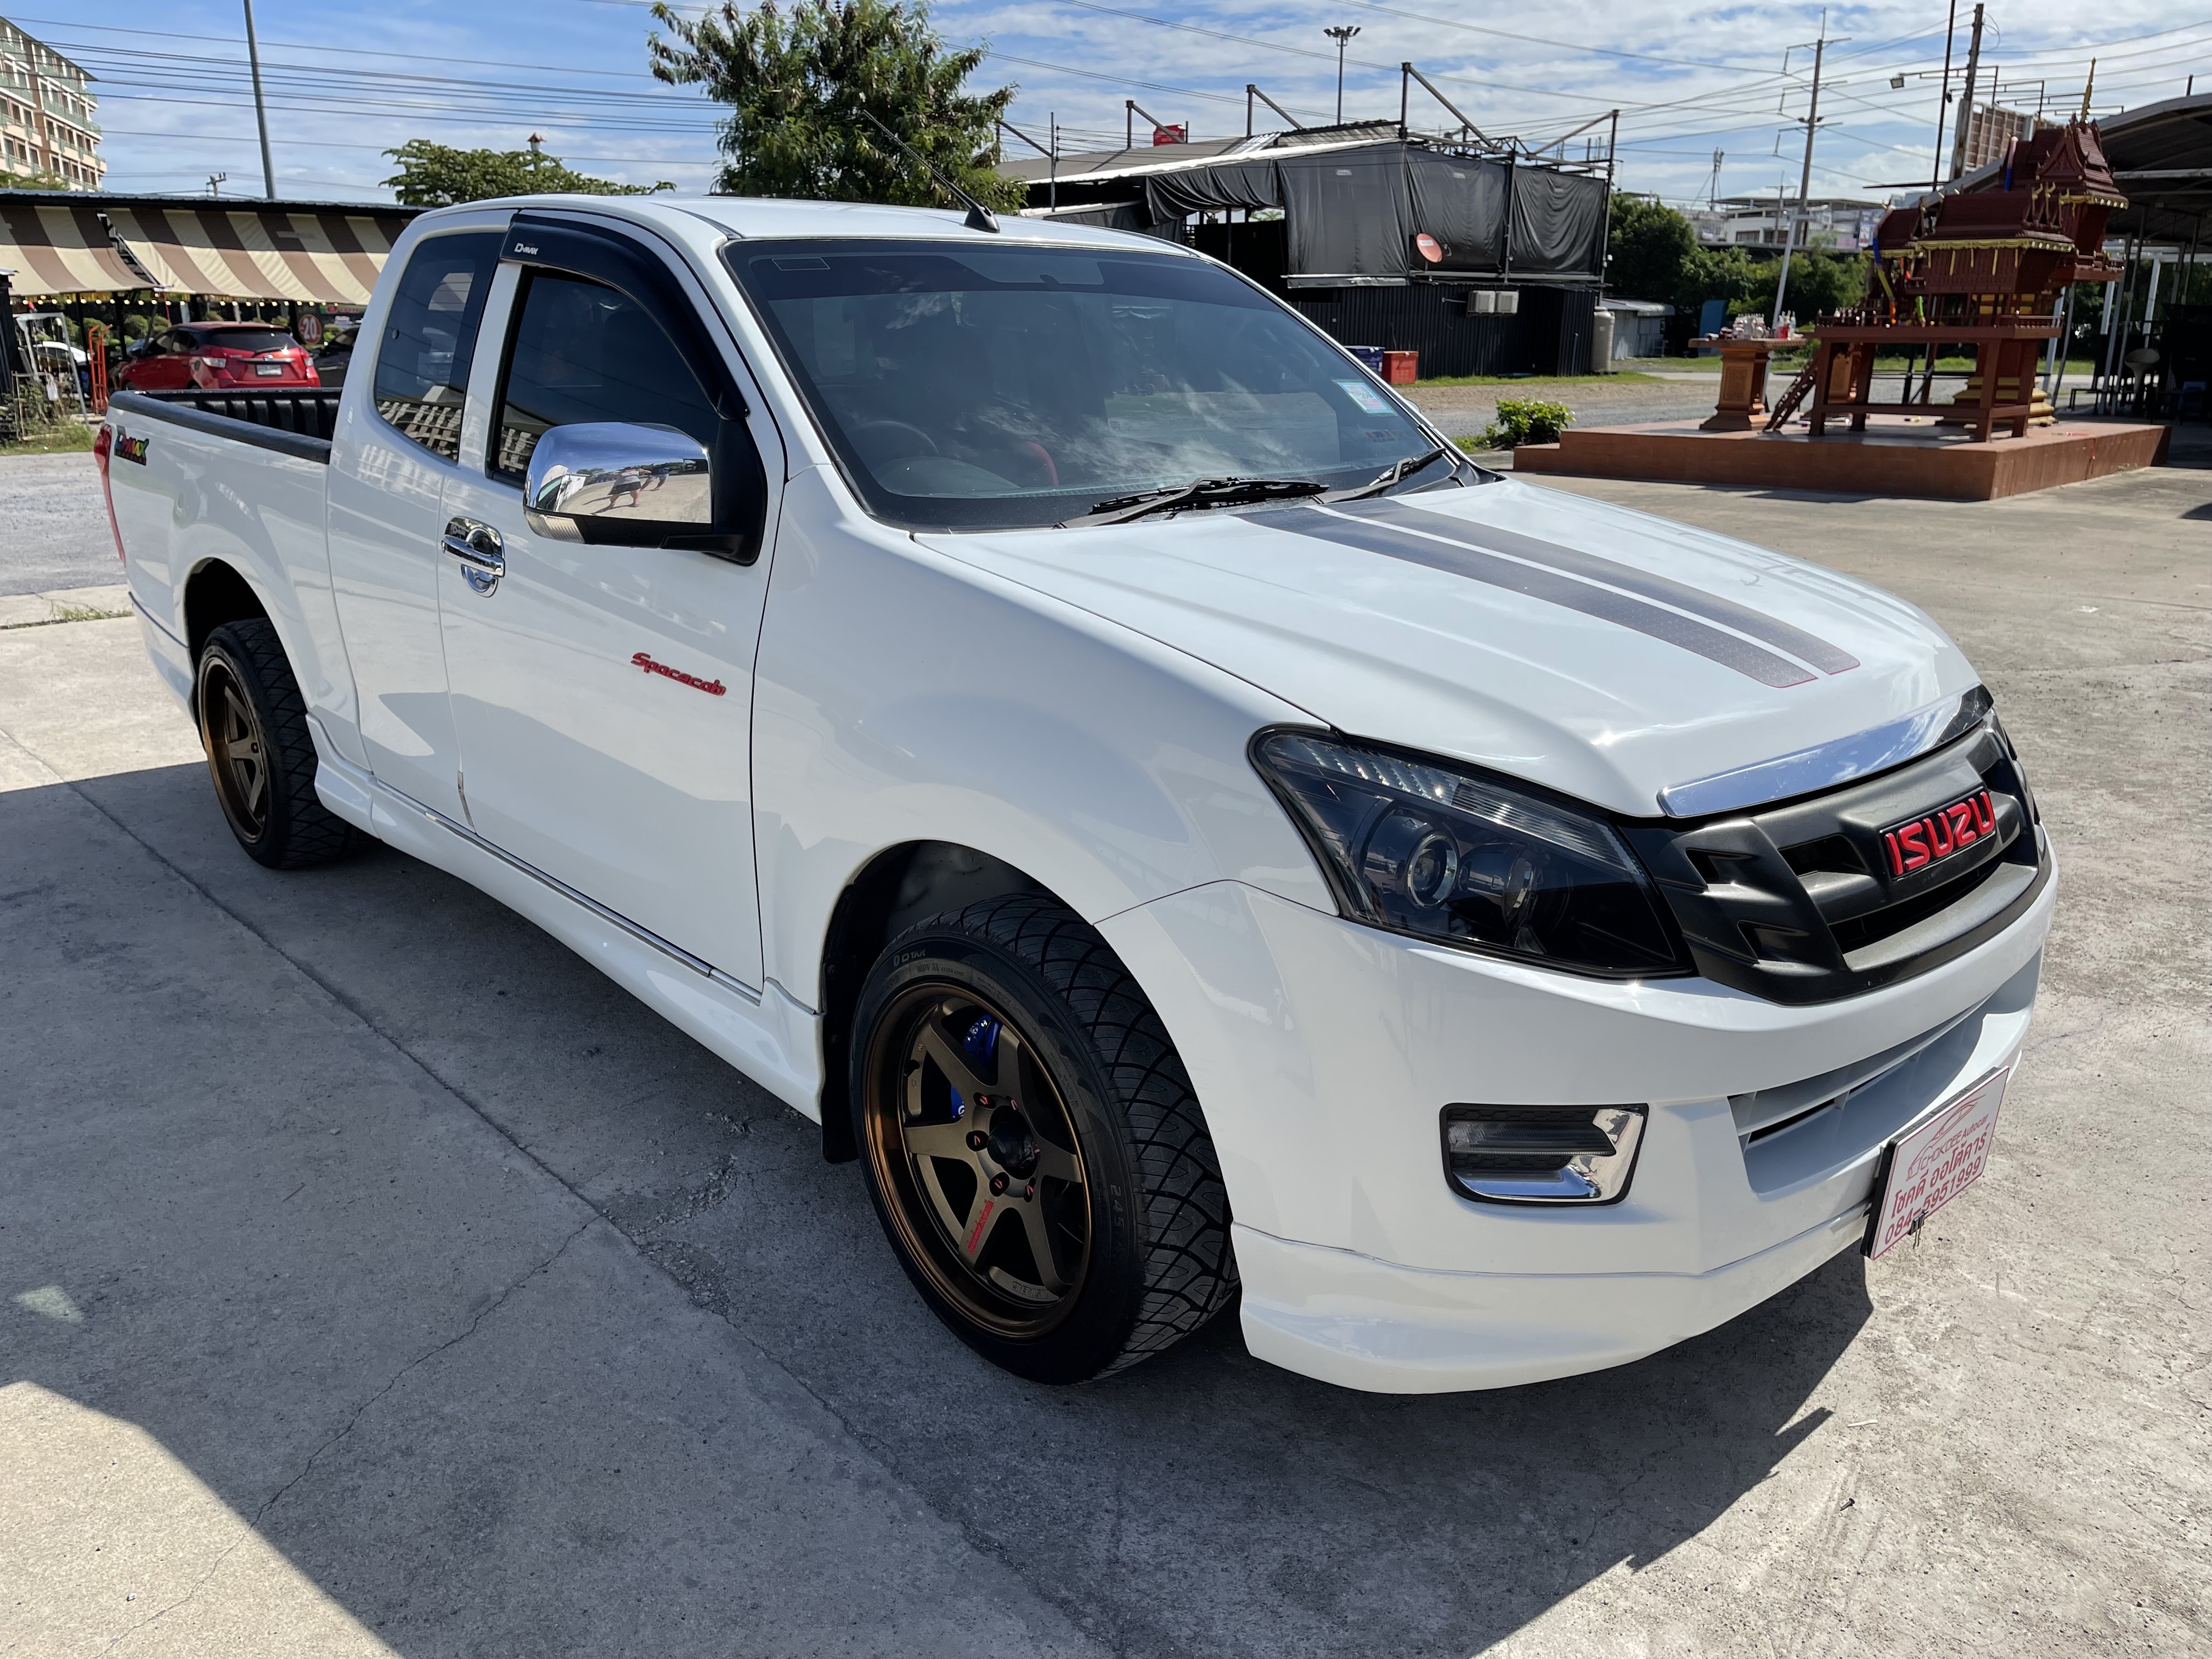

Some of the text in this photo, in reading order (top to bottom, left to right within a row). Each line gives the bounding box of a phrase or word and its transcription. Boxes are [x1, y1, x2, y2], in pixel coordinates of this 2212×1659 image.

[630, 652, 727, 696] Spacecab
[1885, 791, 1995, 876] ISUZU
[1920, 1114, 1989, 1170] CHOKDEE Autocar
[1885, 1155, 1981, 1245] 084-5951999
[1891, 1169, 1929, 1218] โชคดี
